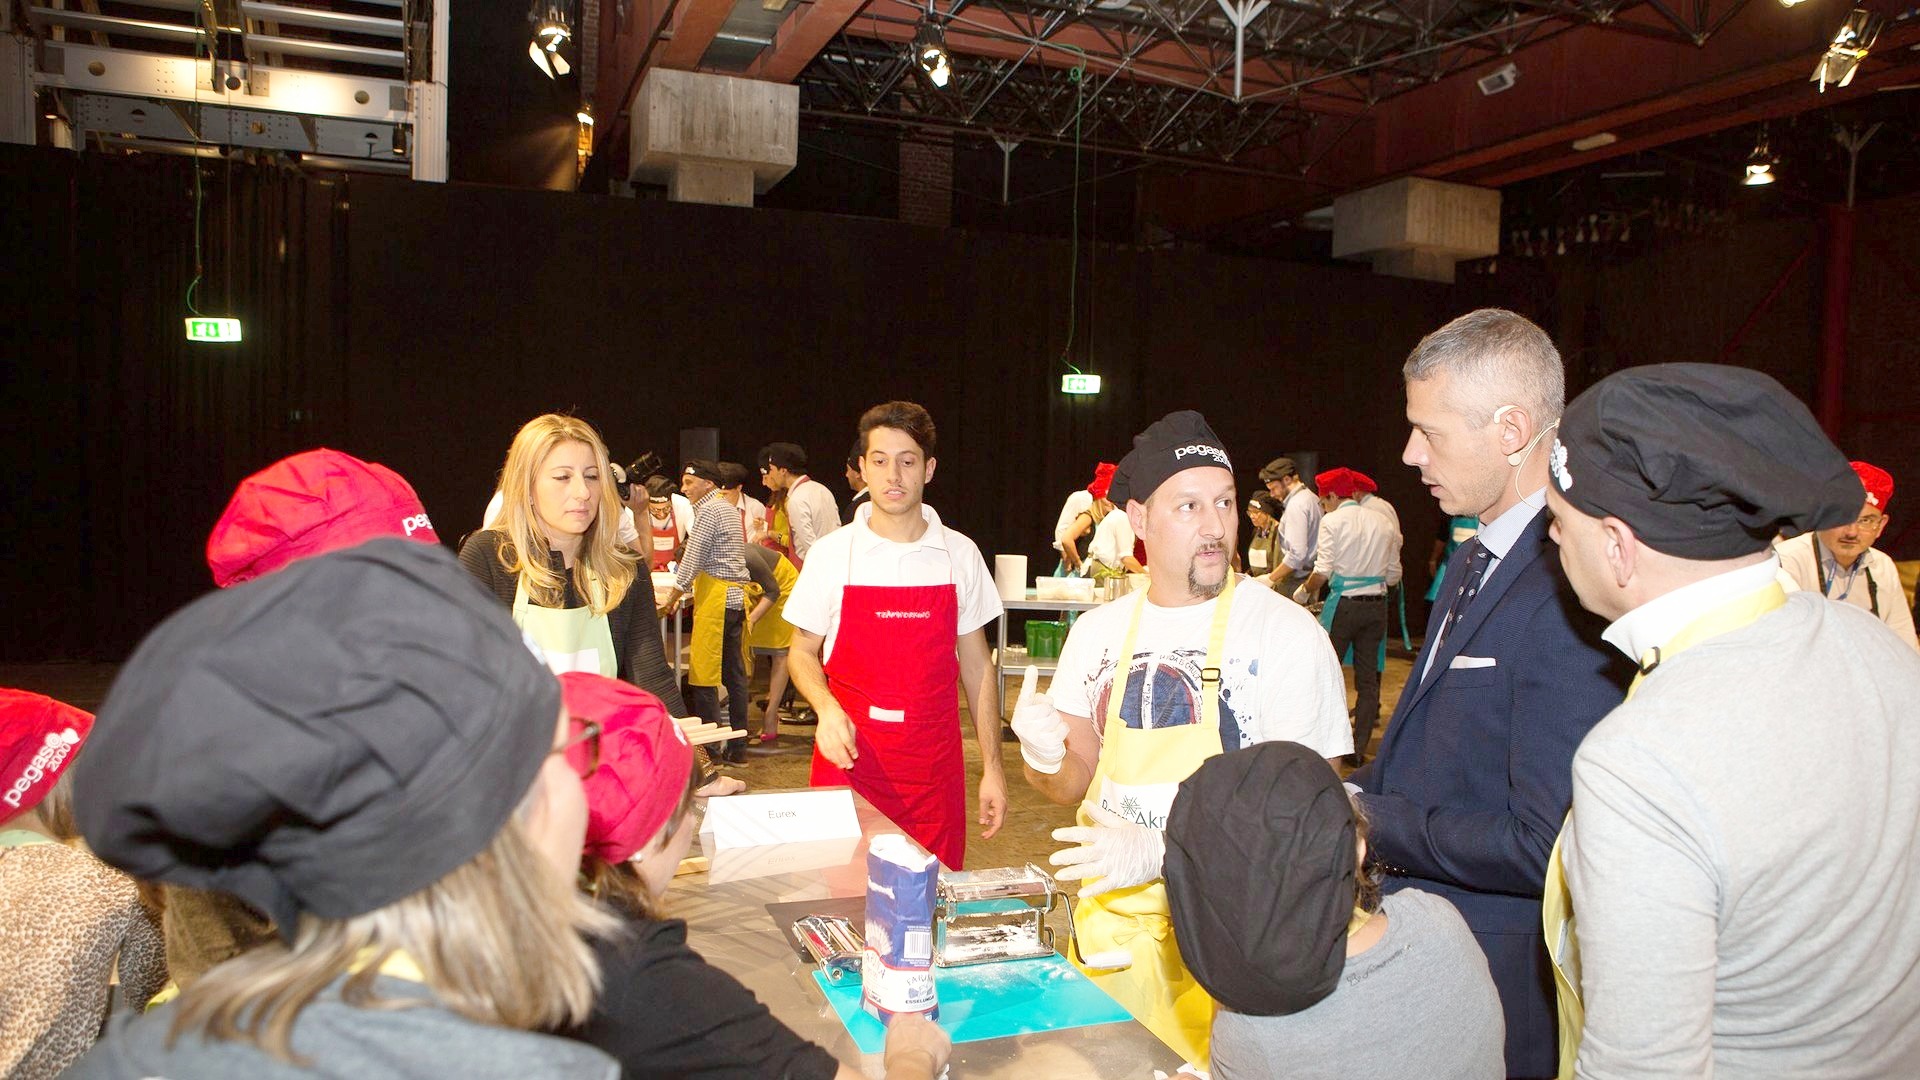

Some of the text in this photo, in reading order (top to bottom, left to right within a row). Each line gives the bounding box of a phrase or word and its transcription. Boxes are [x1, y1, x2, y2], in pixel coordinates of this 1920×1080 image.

[47, 742, 72, 772] 2000
[767, 810, 797, 819] Eurex
[1134, 810, 1167, 829] Akr
